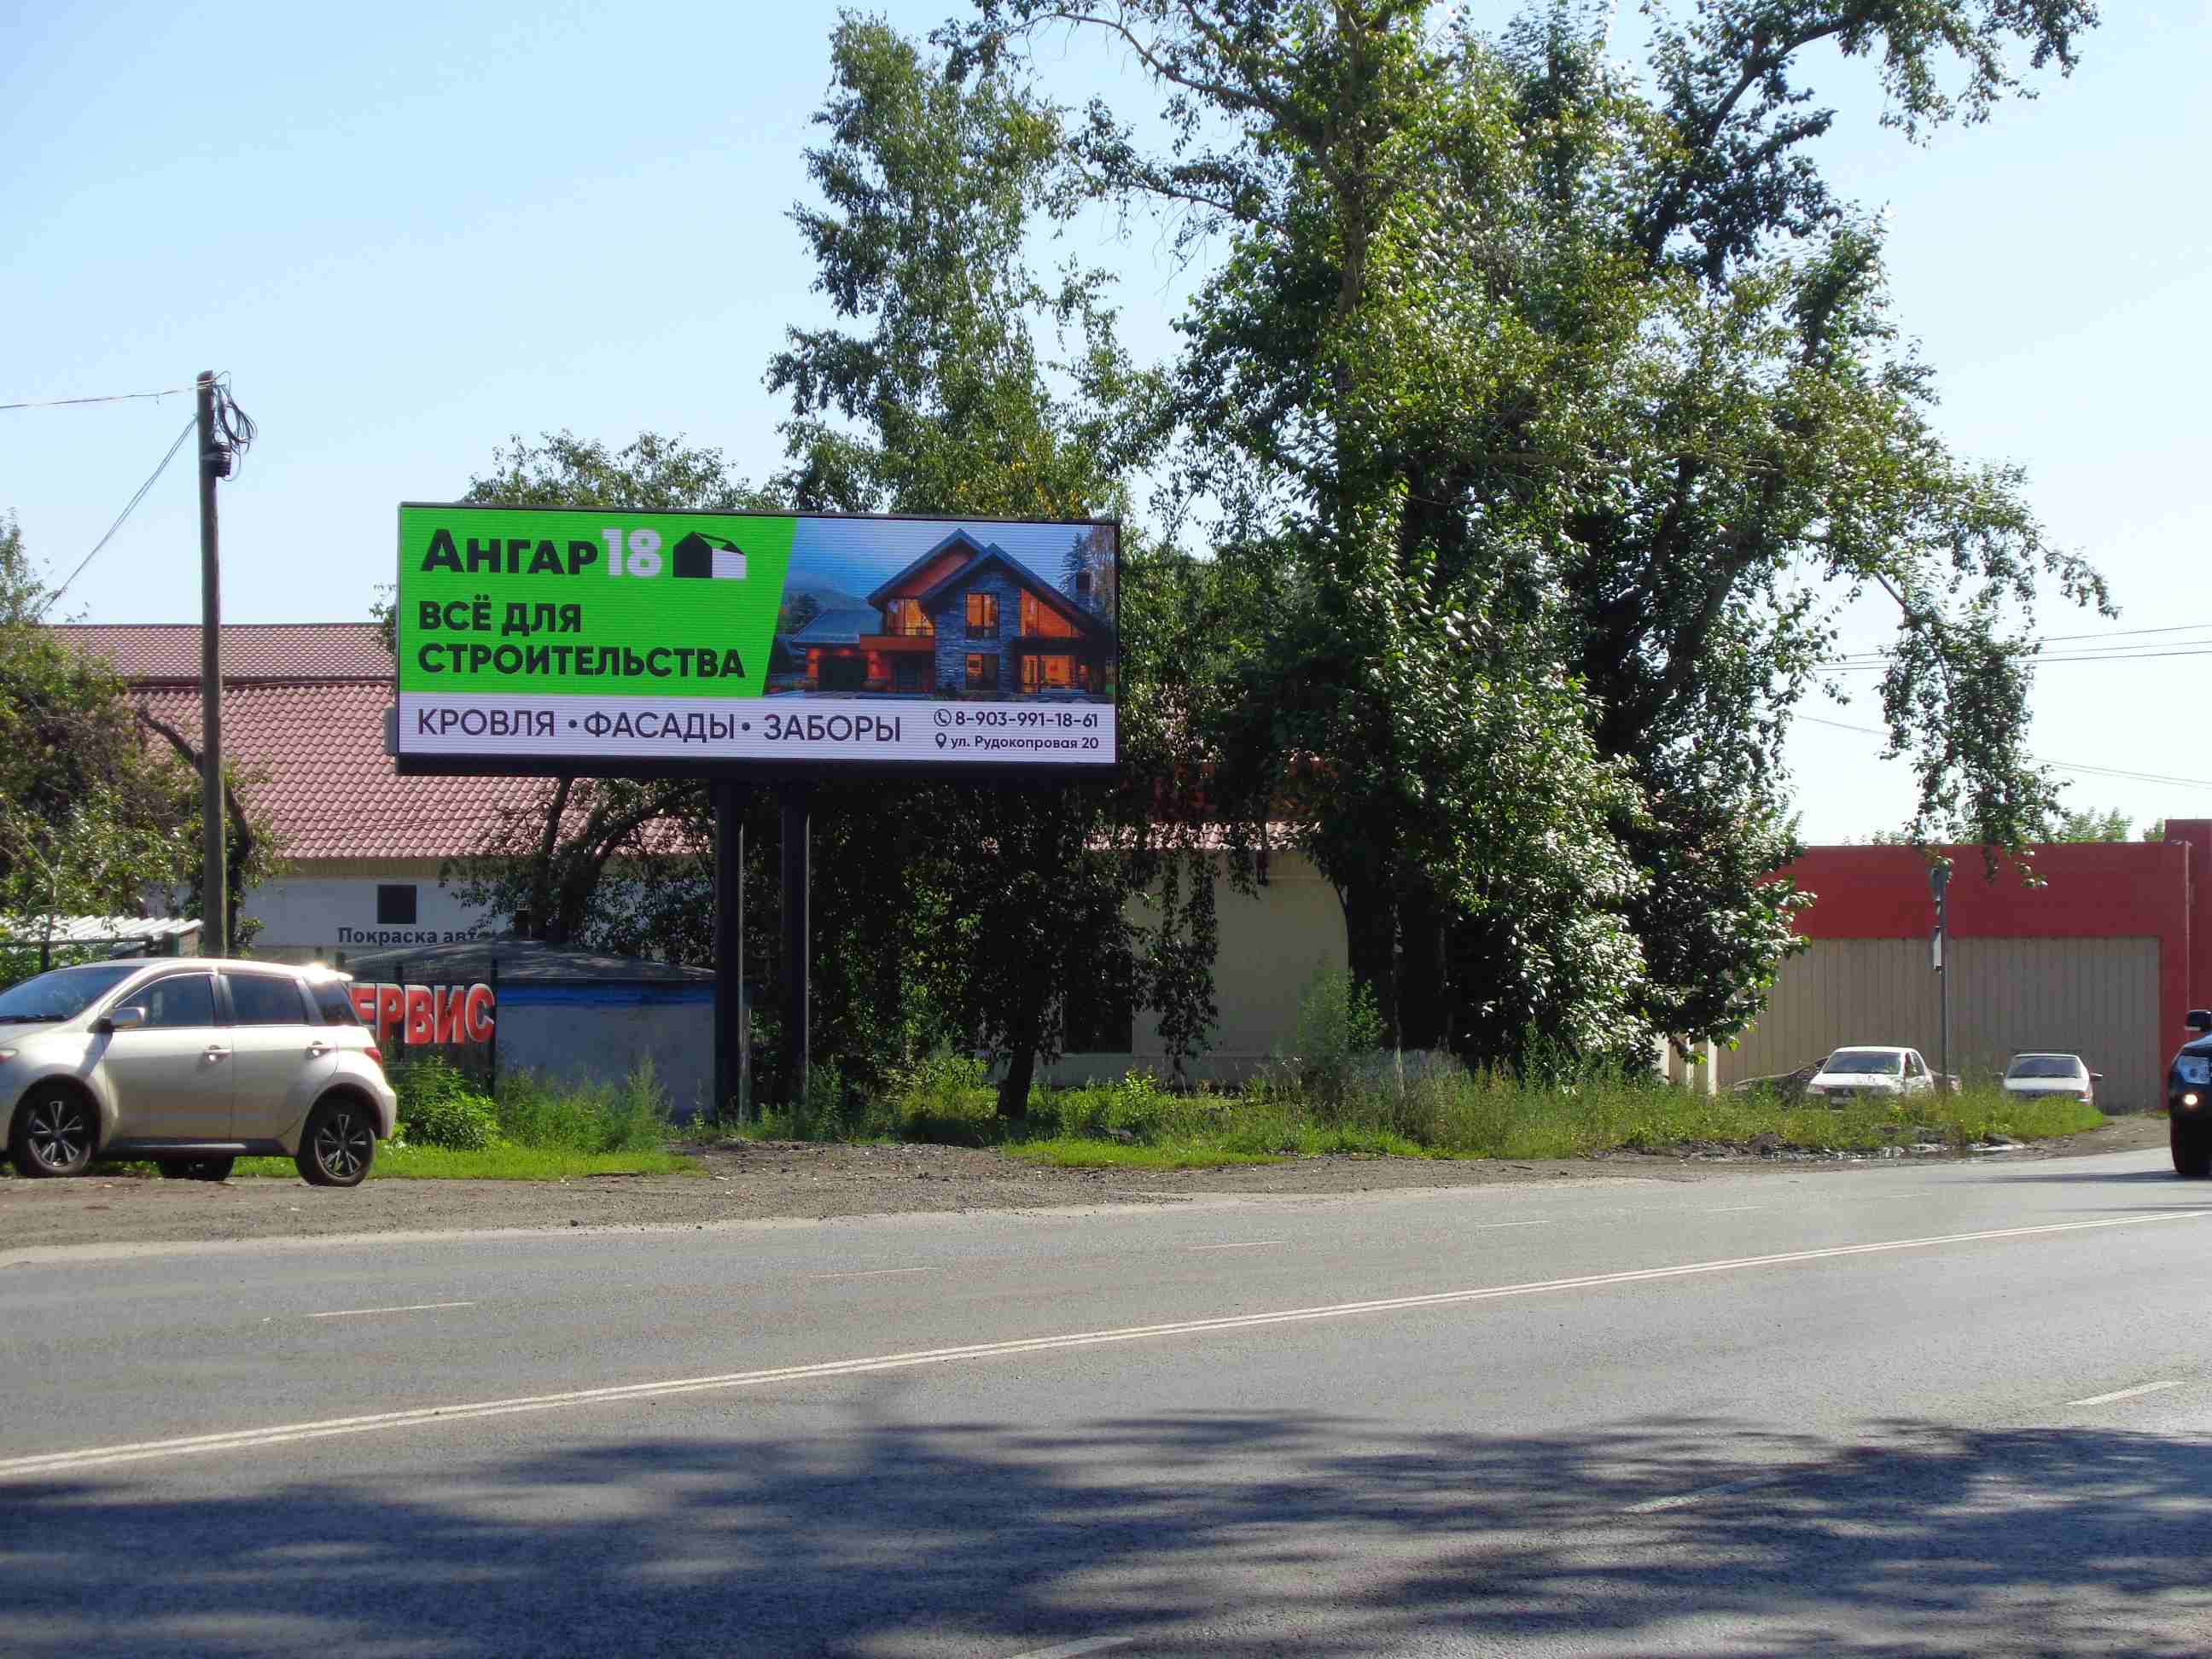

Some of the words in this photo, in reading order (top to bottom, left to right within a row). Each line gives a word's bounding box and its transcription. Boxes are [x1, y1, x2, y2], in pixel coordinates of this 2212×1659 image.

[418, 594, 492, 631] ВСЁ
[501, 601, 582, 637] ДЛЯ
[417, 643, 747, 678] СТРОИТЕЛЬСТВА
[417, 708, 556, 737] КРОВЛЯ
[583, 711, 735, 743] ФАСАДЫ
[763, 714, 901, 742] ЗАБОРЫ
[955, 711, 1098, 728] 8-903-991-18-61
[950, 737, 970, 749] ул.
[975, 735, 1078, 751] Рудокопровая
[1081, 736, 1099, 749] 20
[338, 927, 438, 946] Покраска
[347, 982, 496, 1045] ЕРВИС
